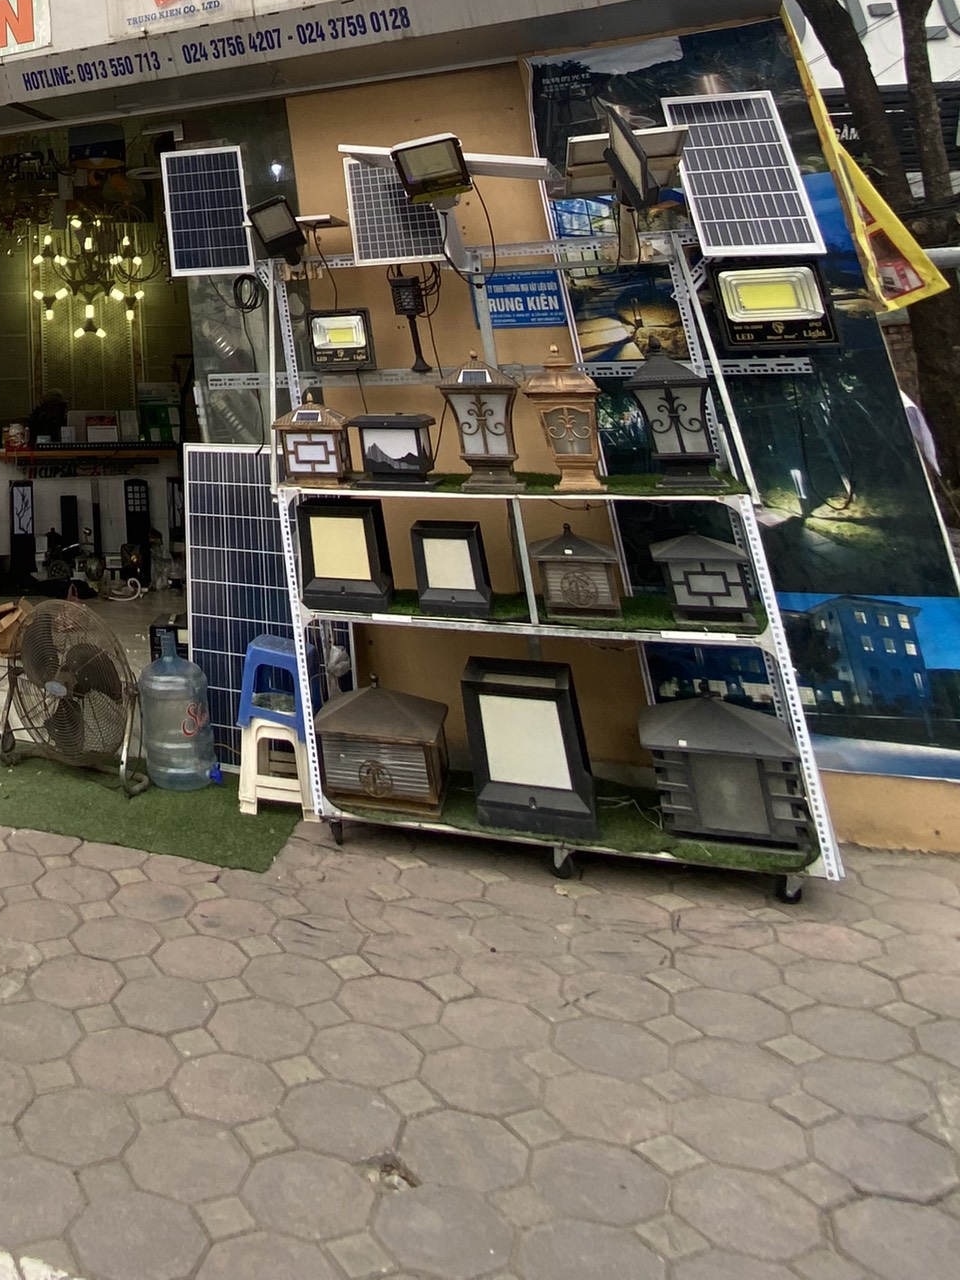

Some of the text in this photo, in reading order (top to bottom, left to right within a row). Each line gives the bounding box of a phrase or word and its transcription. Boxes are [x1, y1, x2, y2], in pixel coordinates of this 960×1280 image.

[127, 13, 157, 26] TRUNG
[158, 7, 182, 20] KIEN
[22, 6, 411, 92] HOTLINE: 0913 550 713 024 3756 4207 024 3759 0128
[488, 293, 559, 312] RUNG KIÊN
[803, 329, 826, 339] Light
